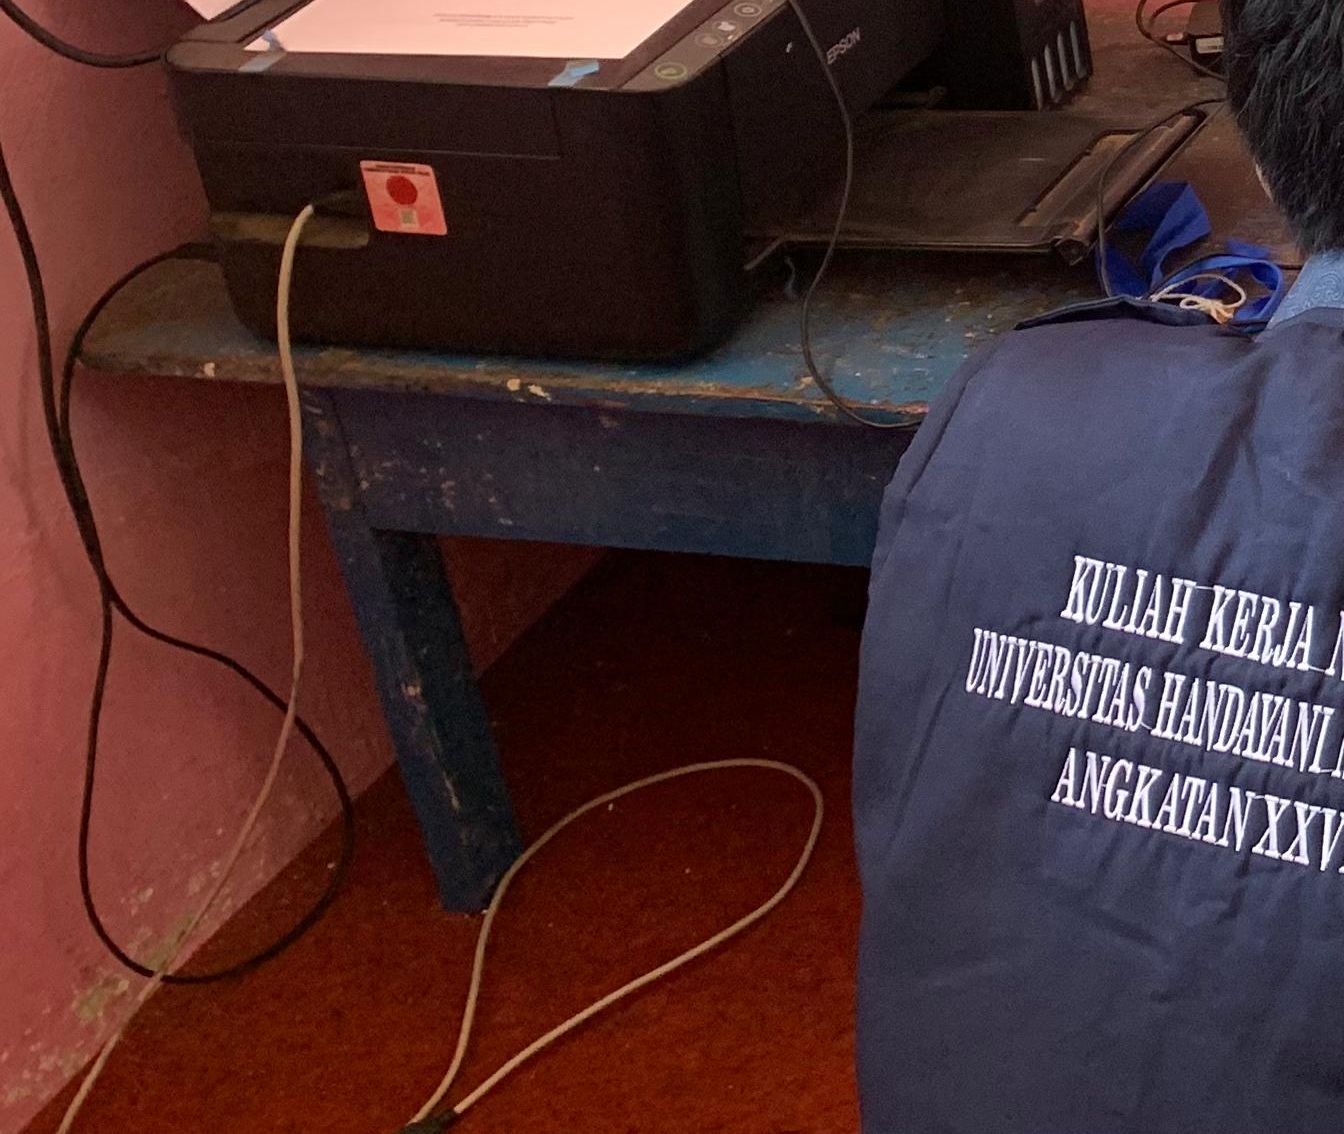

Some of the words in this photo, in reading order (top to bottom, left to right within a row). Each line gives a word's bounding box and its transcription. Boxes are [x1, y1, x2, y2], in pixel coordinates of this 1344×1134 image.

[826, 26, 861, 65] EPSON
[1060, 554, 1197, 644] KULIAH
[1199, 584, 1317, 672] KERJA
[964, 627, 1152, 734] UNIVERSITAS
[1150, 670, 1336, 774] HANDAYANI
[1051, 747, 1254, 852] ANGKATAN
